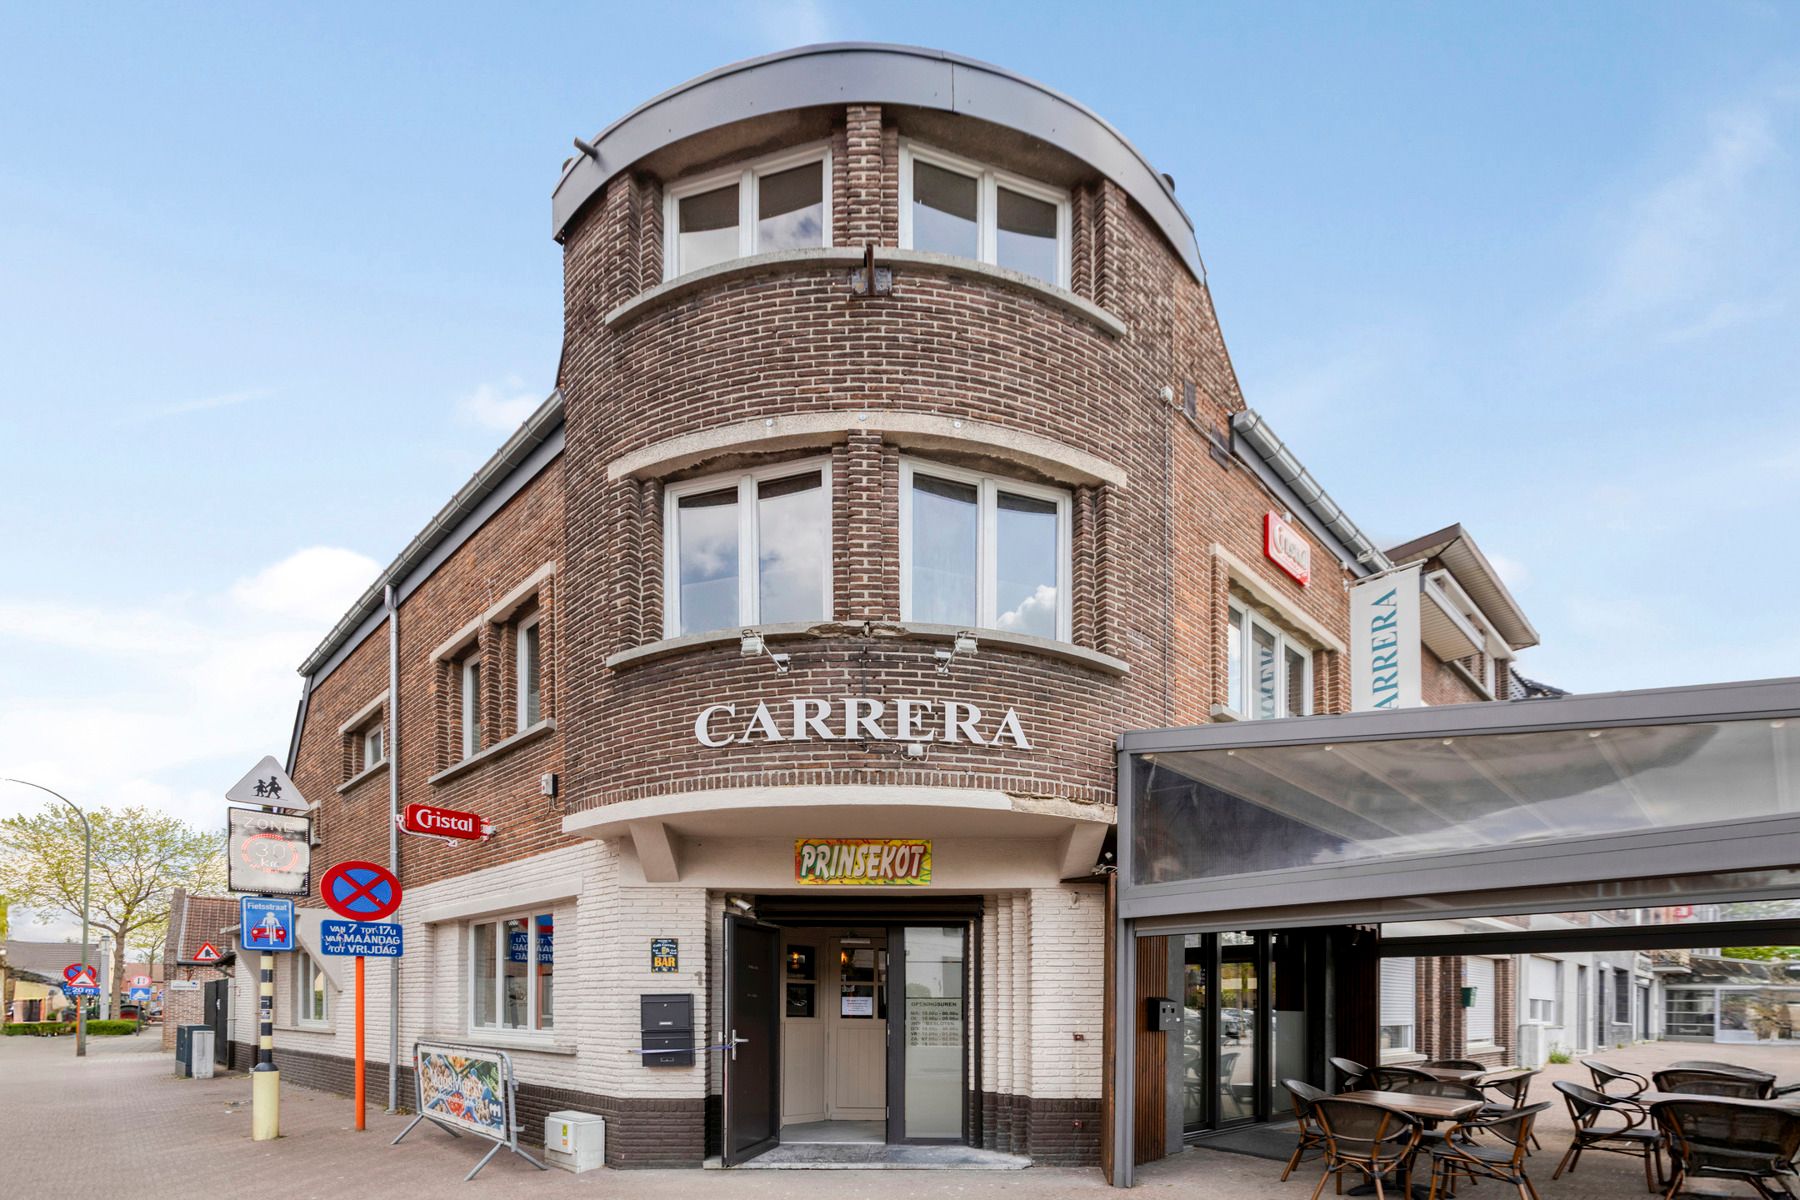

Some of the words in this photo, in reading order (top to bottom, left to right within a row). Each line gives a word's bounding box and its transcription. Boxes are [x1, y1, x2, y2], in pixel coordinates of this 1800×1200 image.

[694, 697, 1034, 750] CARRERA
[243, 816, 295, 833] ZONE
[416, 808, 473, 832] Cristal
[255, 841, 286, 860] 30
[801, 844, 926, 880] PRINSEKOT
[247, 902, 288, 911] Fietsstraat
[329, 925, 346, 933] VAN
[348, 923, 358, 933] 7
[360, 926, 376, 934] TOT
[379, 925, 397, 935] 17u
[344, 934, 400, 945] MAANDAG
[347, 944, 397, 955] VRIJDAG
[655, 956, 676, 967] BAR
[694, 971, 703, 986] 1
